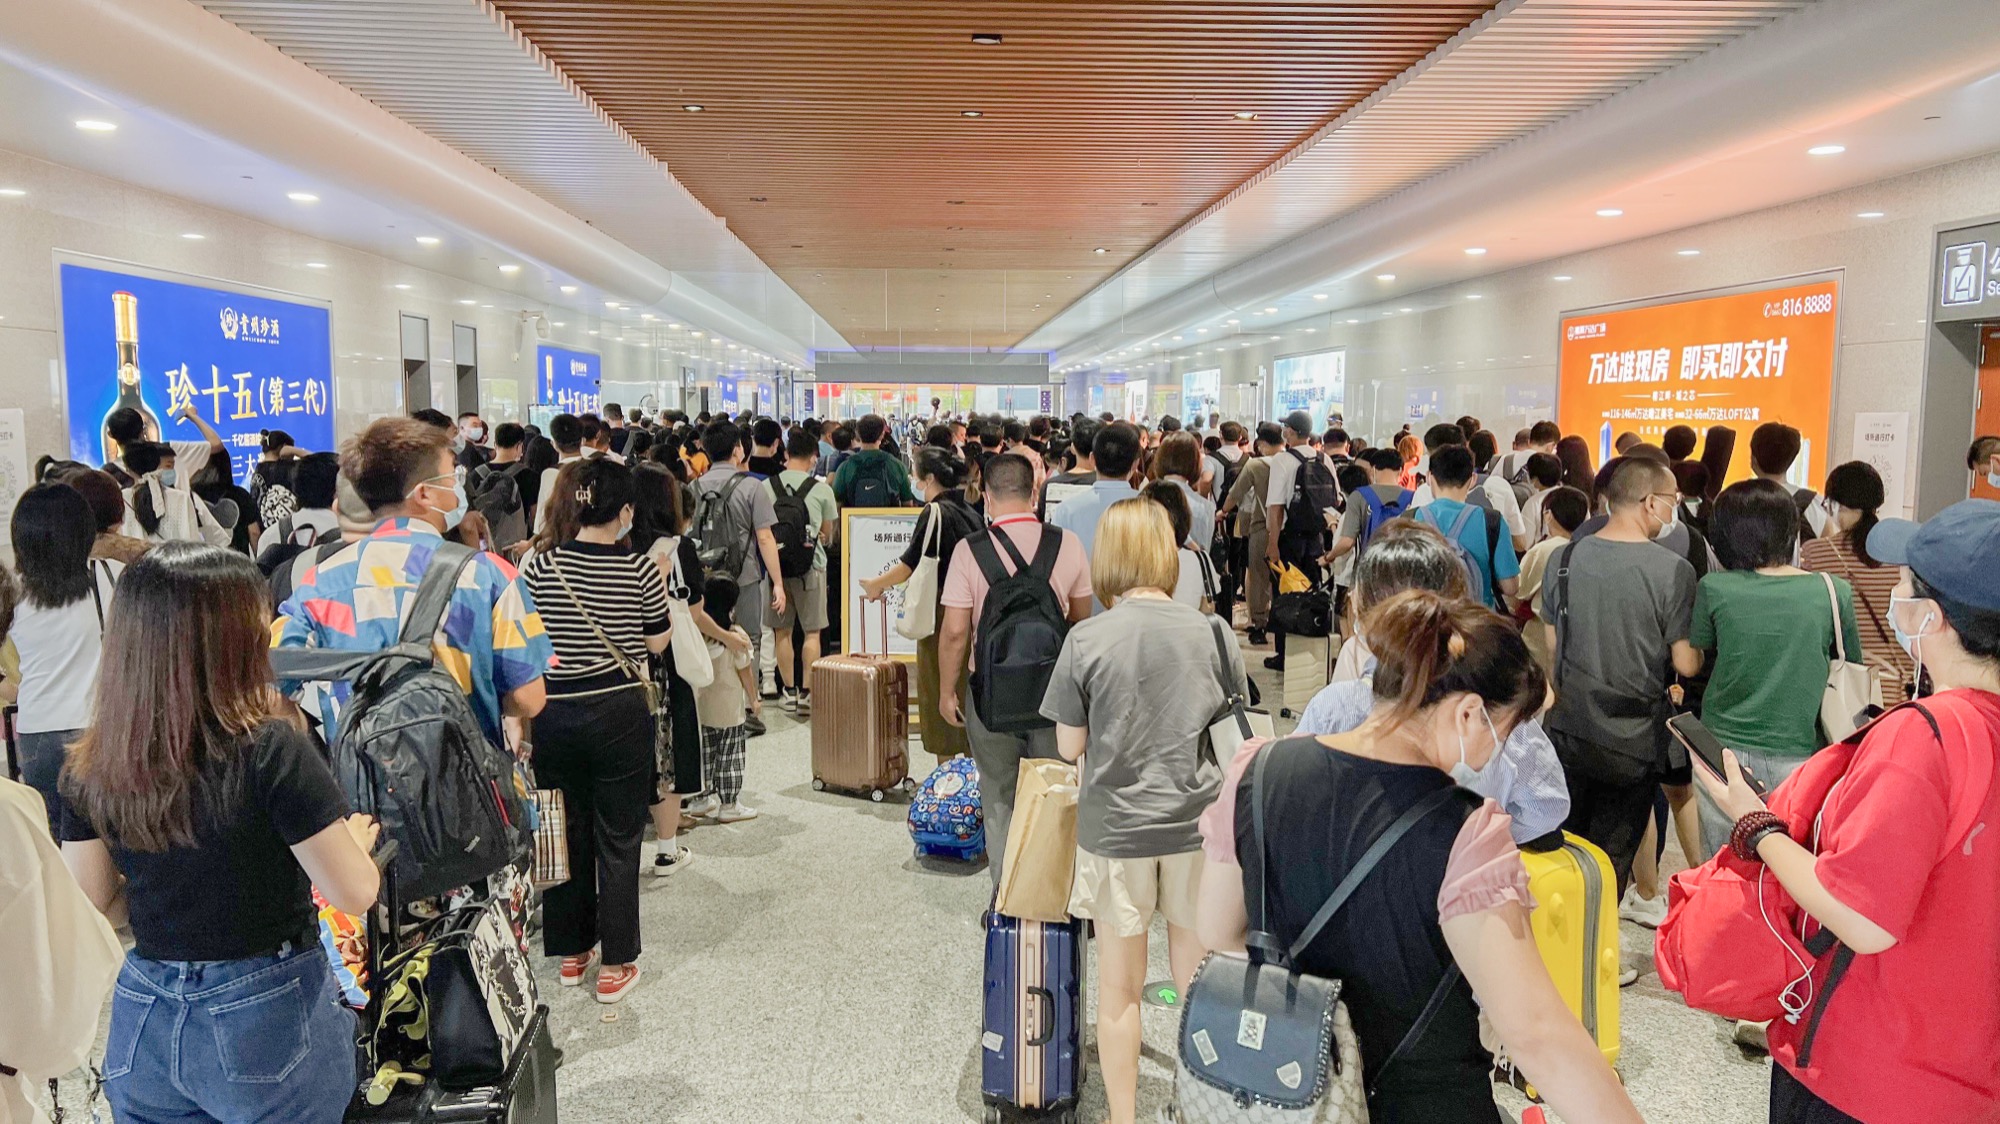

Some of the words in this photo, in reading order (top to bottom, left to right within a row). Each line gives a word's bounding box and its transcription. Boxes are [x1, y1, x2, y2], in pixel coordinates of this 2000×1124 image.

[1782, 297, 1802, 317] 816
[1804, 293, 1832, 315] 8888
[1587, 347, 1671, 385] 万达准现房
[1679, 336, 1788, 381] 即买即交付
